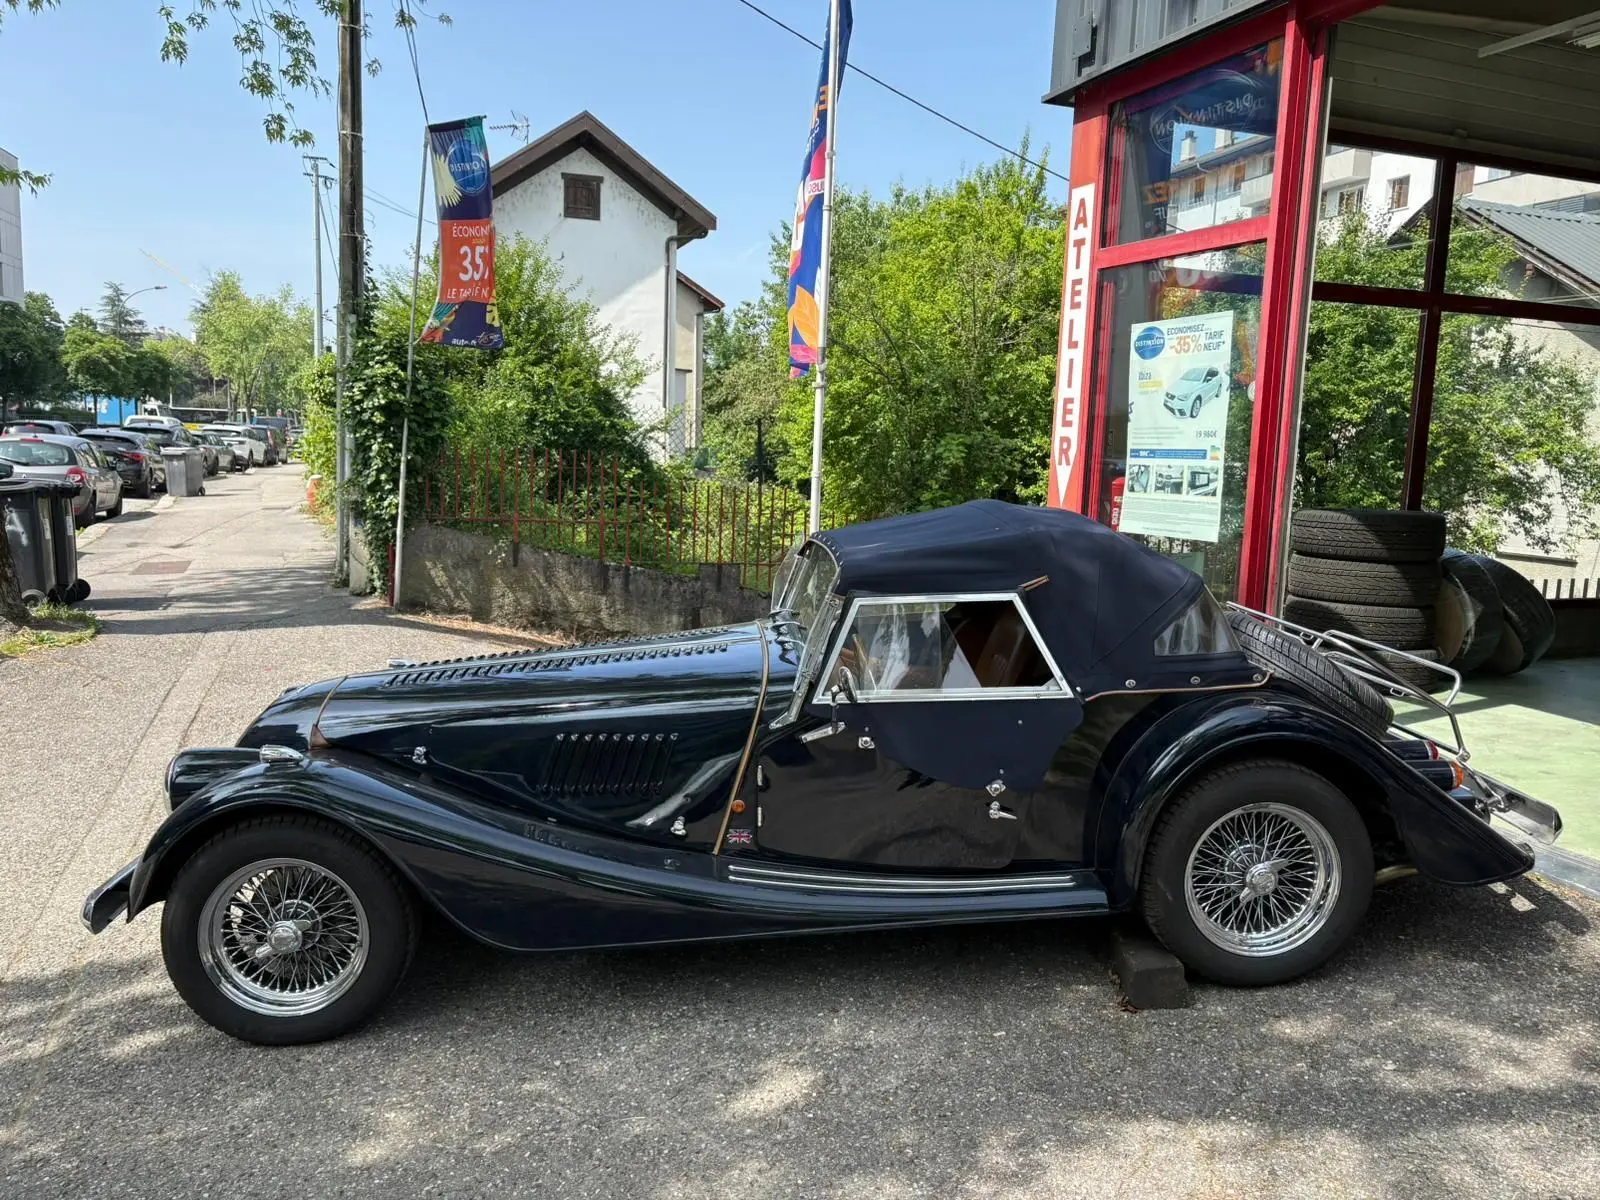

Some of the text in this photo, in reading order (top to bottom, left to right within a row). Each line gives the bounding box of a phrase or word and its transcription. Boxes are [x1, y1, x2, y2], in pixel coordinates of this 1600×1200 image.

[447, 286, 490, 299] LE TARIF N
[1057, 198, 1088, 466] ATELIER
[1205, 330, 1225, 341] TARIF
